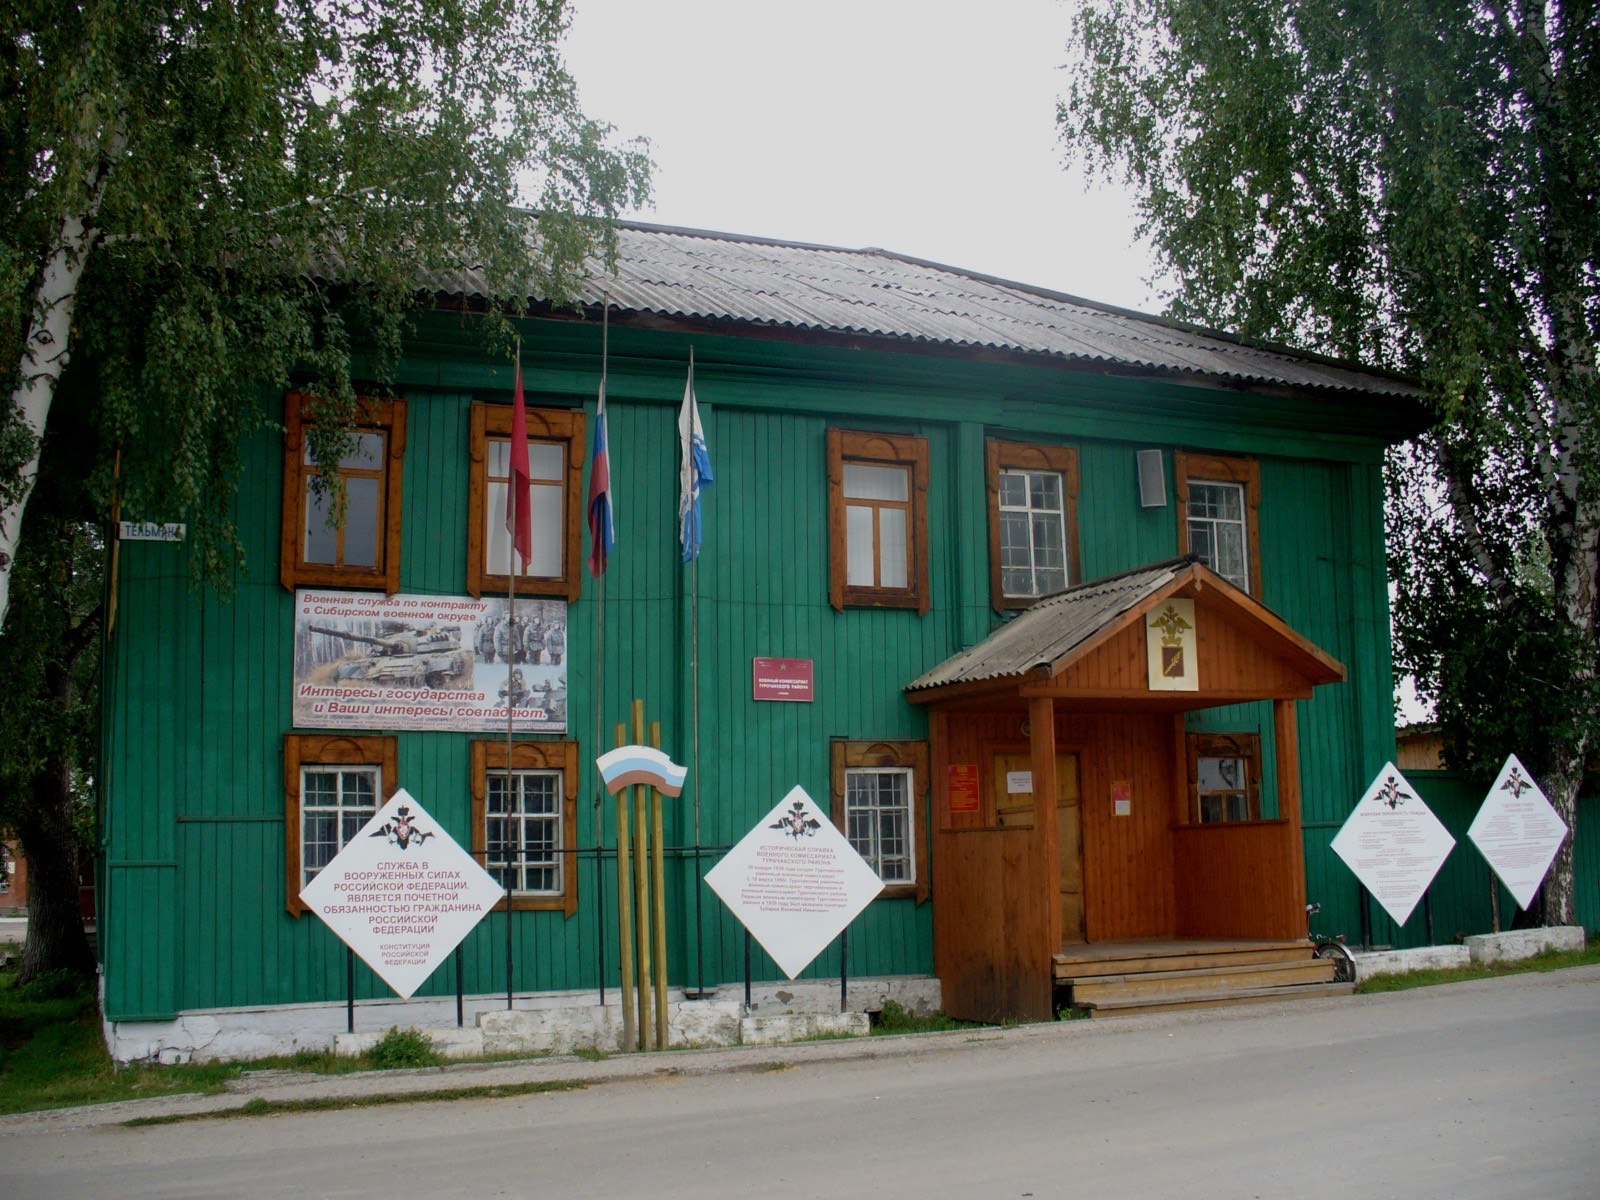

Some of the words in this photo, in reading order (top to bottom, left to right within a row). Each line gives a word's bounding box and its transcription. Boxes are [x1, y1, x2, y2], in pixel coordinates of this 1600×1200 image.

[125, 524, 178, 538] ТЕЛЬМАН
[303, 594, 354, 605] Военная
[357, 598, 400, 608] служба
[403, 600, 417, 608] по
[420, 601, 487, 612] контракту
[303, 606, 310, 614] в
[314, 606, 380, 618] Сибирском
[383, 610, 434, 619] военном
[437, 613, 476, 623] округе
[300, 685, 382, 699] Интересы
[386, 688, 485, 701] государства
[314, 704, 323, 713] и
[327, 702, 371, 714] Ваши
[374, 705, 453, 718] интересы
[457, 707, 547, 719] совпадают.
[377, 862, 419, 871] СЛУЖБА
[422, 862, 429, 870] В
[344, 871, 424, 881] ВООРУЖЕННЫХ
[427, 871, 461, 879] СИЛАХ
[333, 881, 404, 892] РОССИЙСКОЙ
[347, 894, 401, 903] ЯВЛЯЕТСЯ
[404, 892, 459, 902] ПОЧЕТНОЙ
[323, 904, 410, 914] ОБЯЗАННОСТЬЮ
[413, 903, 482, 913] ГРАЖДАНИНА
[368, 914, 438, 924] РОССИЙСКОЙ
[372, 925, 435, 935] ФЕДЕРАЦИИ
[380, 943, 430, 951] КОНСТИТУЦИЯ
[382, 950, 429, 958] РОССИЙСКОЙ
